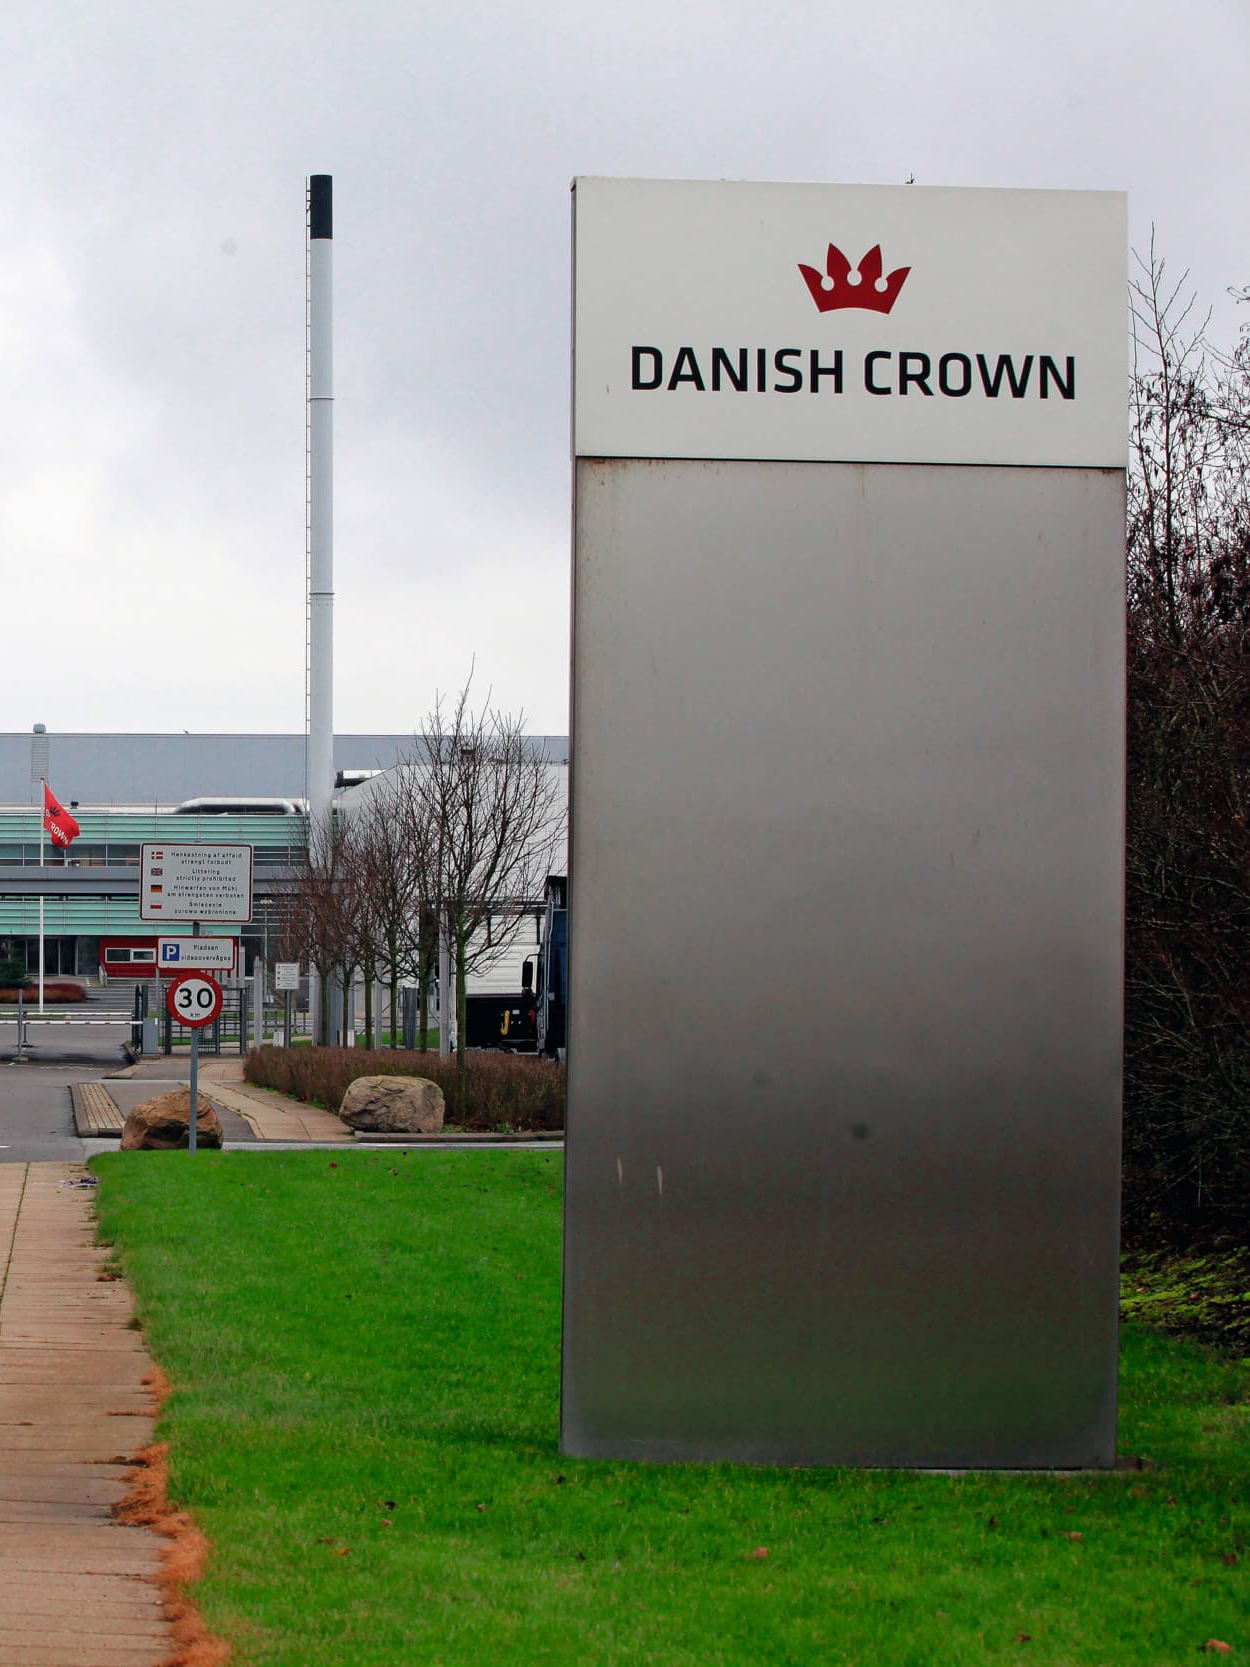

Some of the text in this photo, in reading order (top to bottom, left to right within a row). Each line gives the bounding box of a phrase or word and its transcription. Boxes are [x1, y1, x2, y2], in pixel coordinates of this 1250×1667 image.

[631, 346, 1076, 400] DANISH CROWN
[192, 868, 220, 876] Littering
[166, 945, 177, 960] P
[178, 988, 213, 1009] 30
